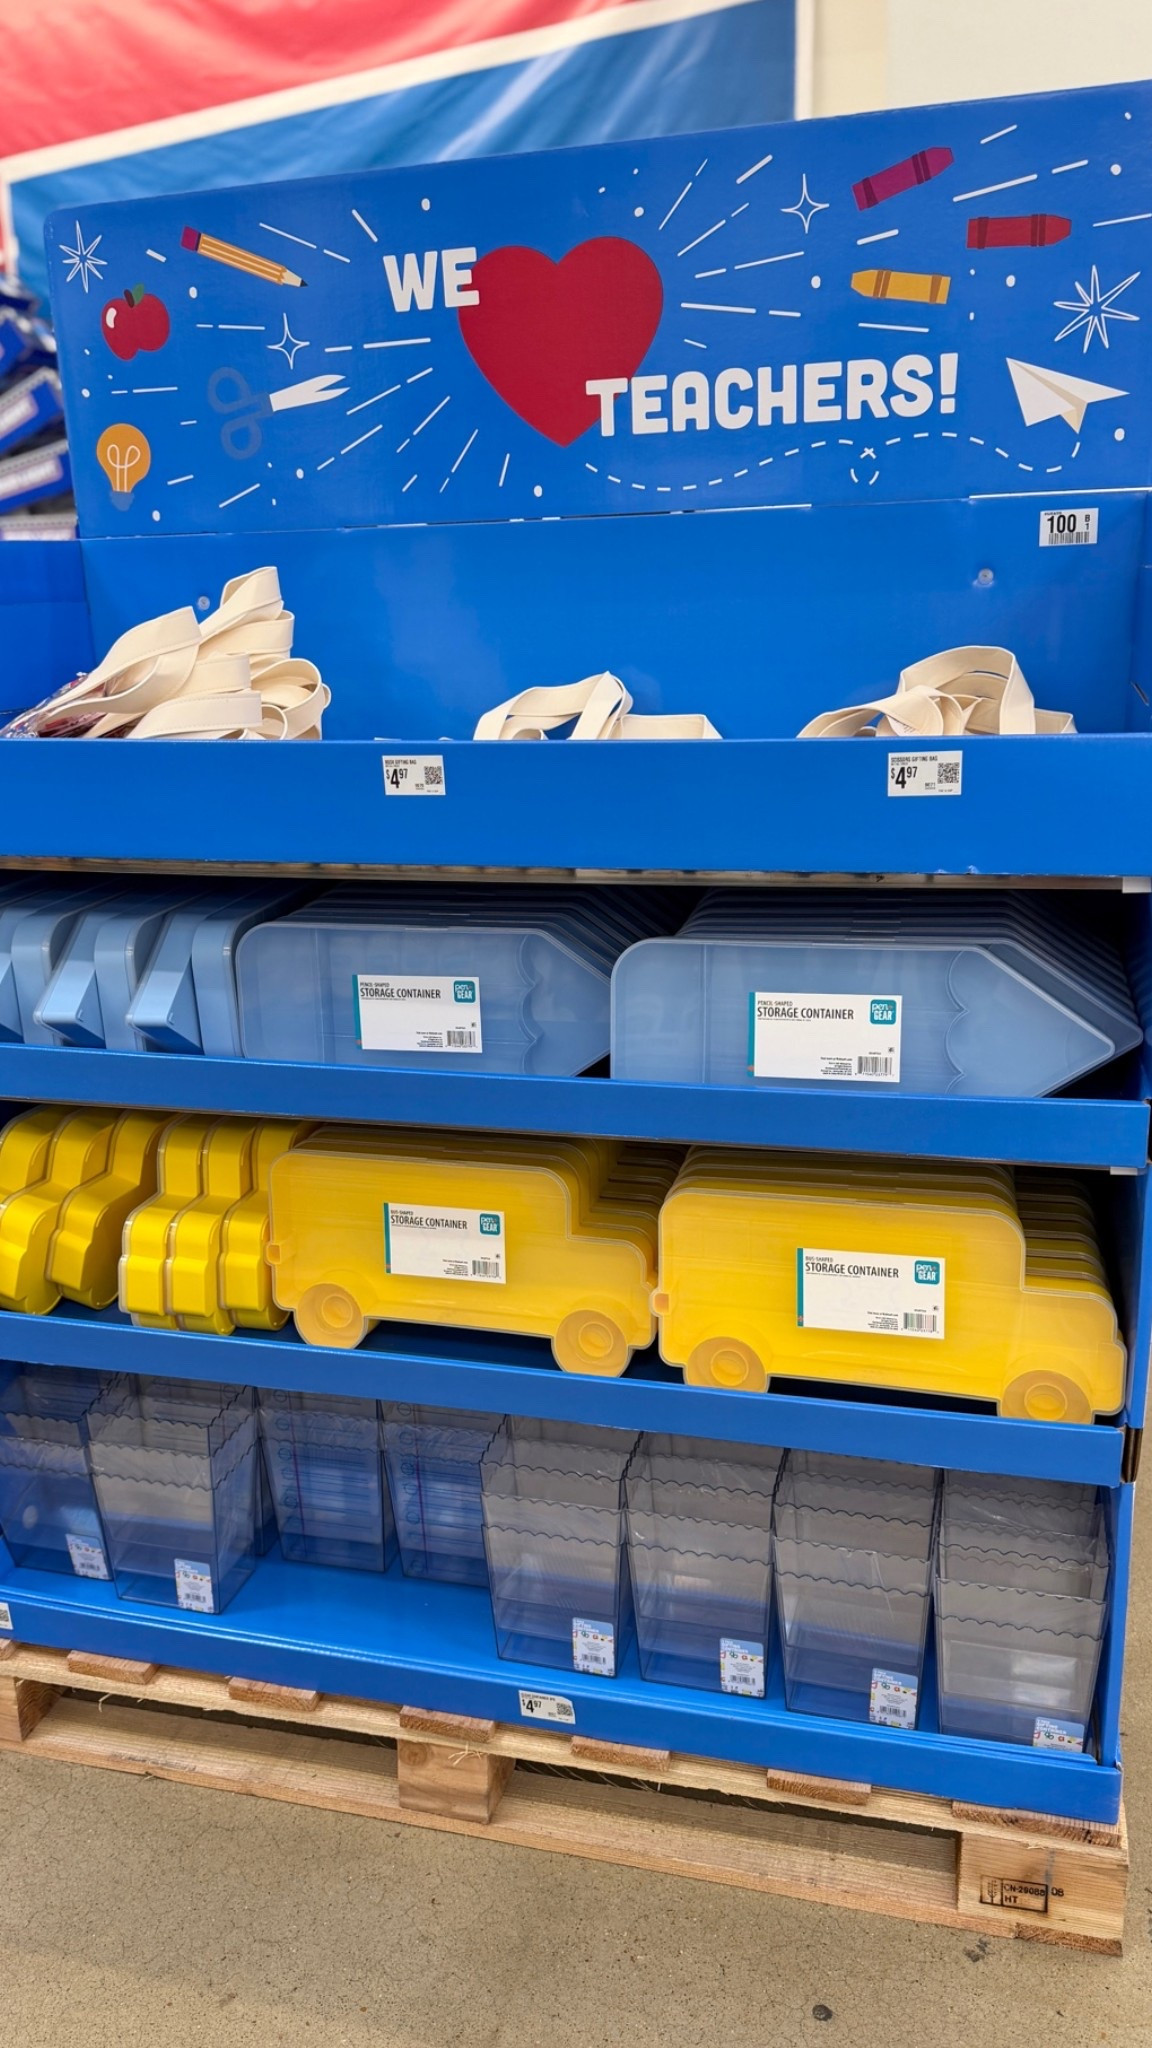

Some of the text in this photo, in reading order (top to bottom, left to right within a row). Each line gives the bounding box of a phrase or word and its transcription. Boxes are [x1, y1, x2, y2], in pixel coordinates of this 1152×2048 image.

[383, 247, 480, 312] WE
[585, 353, 959, 436] TEACHERS!
[1047, 514, 1077, 534] 100
[360, 988, 442, 999] STORAGE CONTAINER
[456, 991, 473, 999] GEAR
[757, 1007, 855, 1020] STORAGE CONTAINER
[873, 1011, 892, 1021] GEAR
[391, 1215, 424, 1226] STORAGE
[425, 1217, 468, 1230] CONTAINER
[482, 1222, 498, 1232] GEAR
[805, 1262, 845, 1274] STORAGE
[847, 1265, 899, 1278] CONTAINER
[918, 1271, 936, 1281] GEAR
[1004, 1895, 1018, 1904] HT
